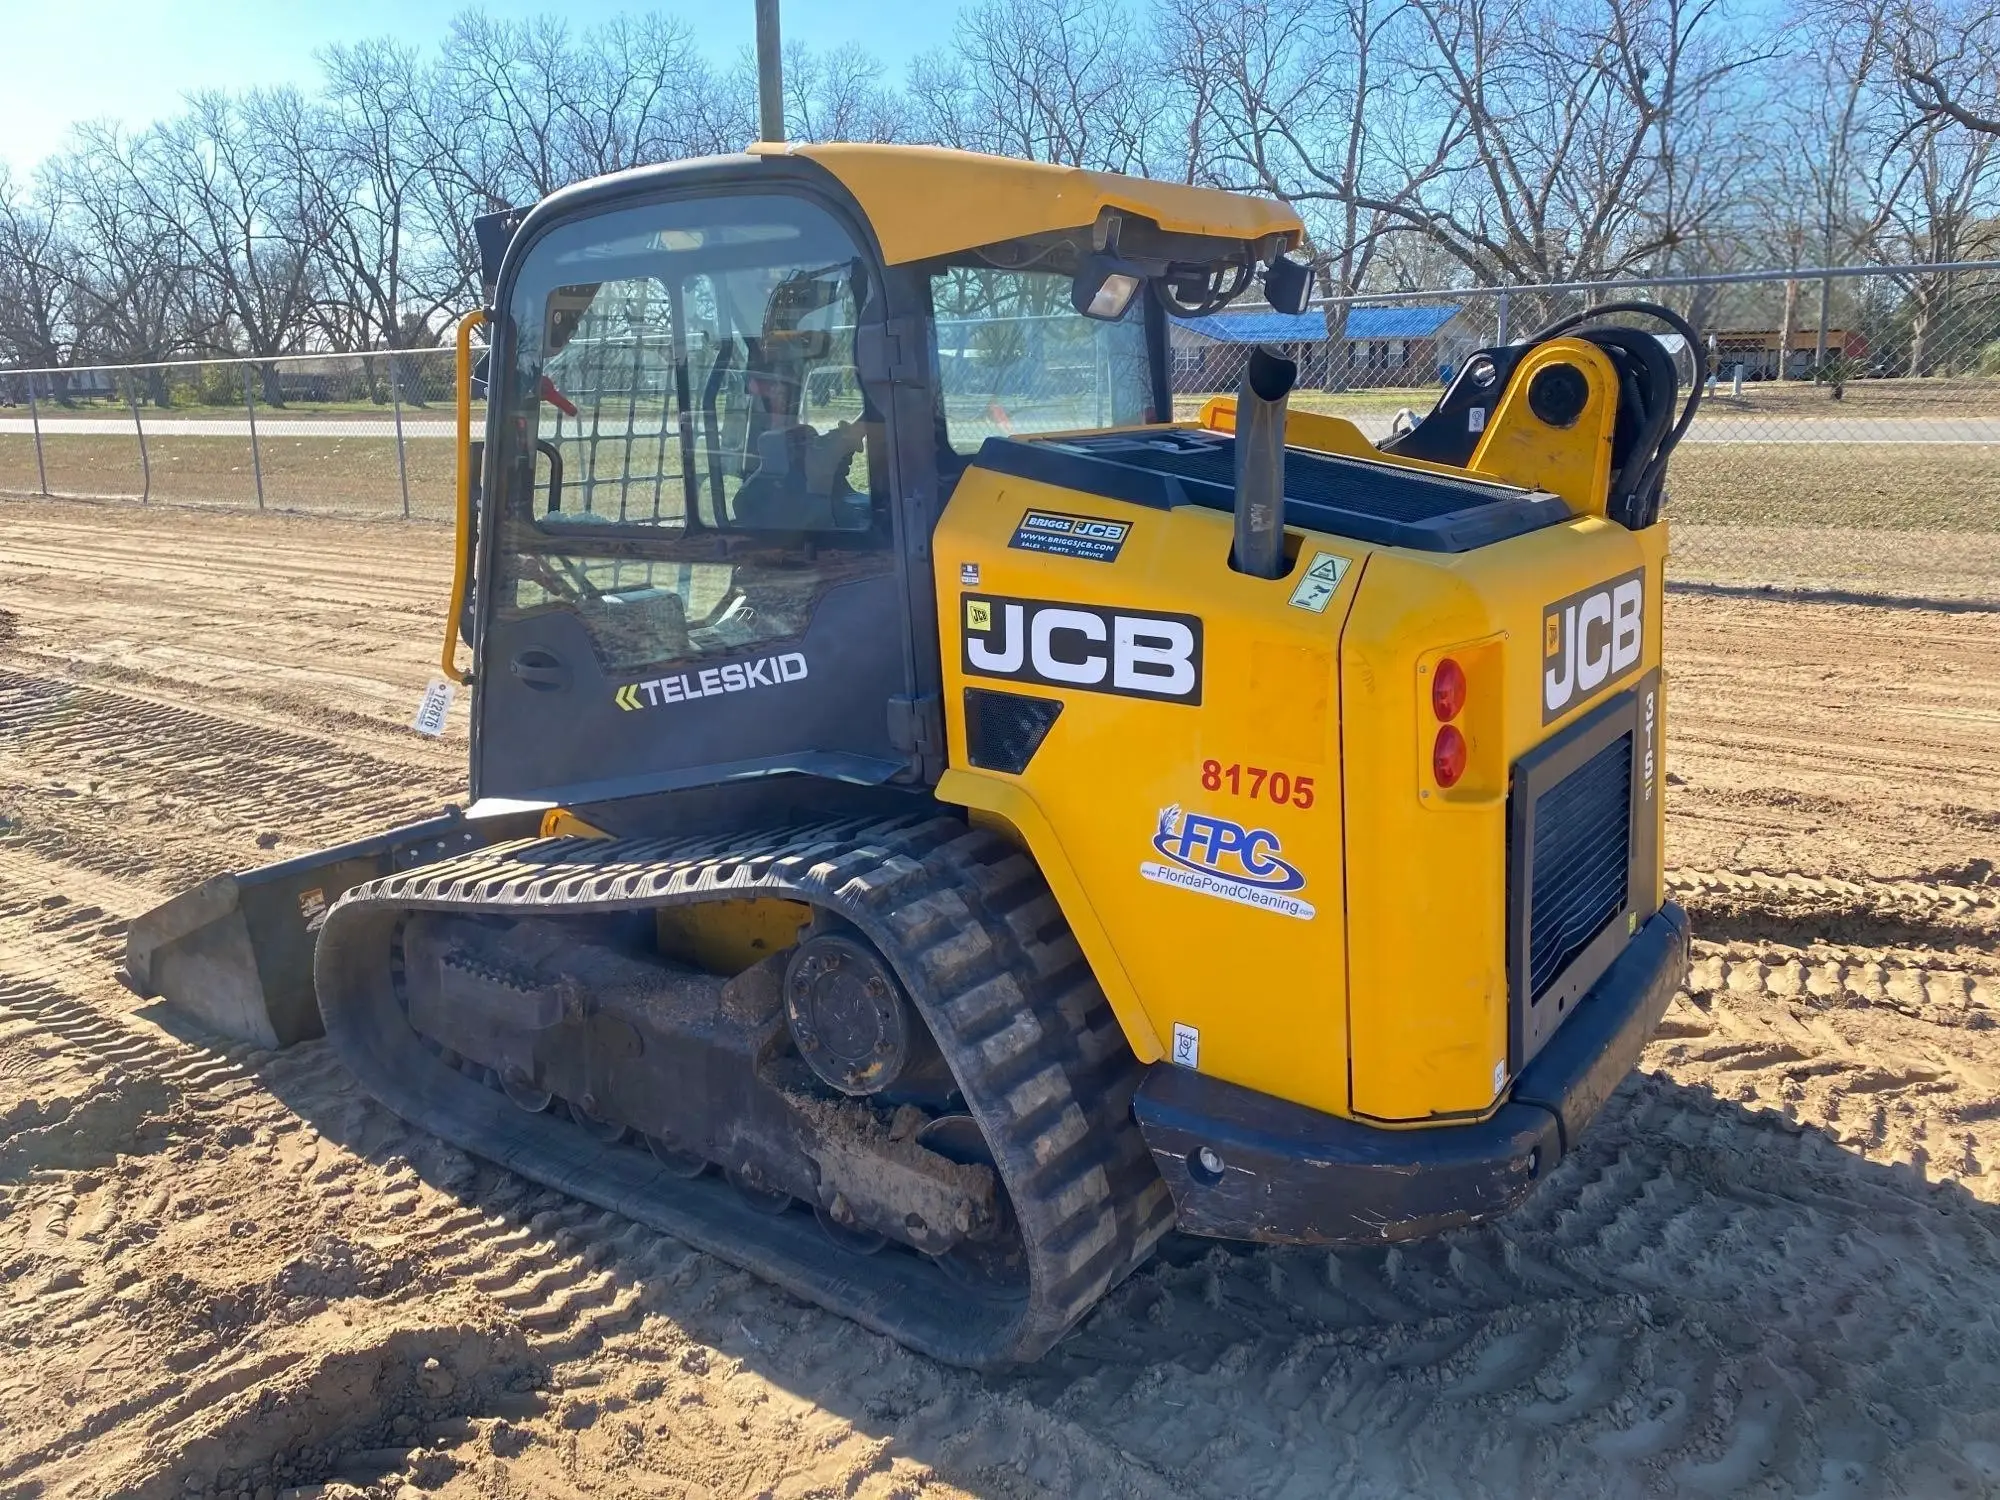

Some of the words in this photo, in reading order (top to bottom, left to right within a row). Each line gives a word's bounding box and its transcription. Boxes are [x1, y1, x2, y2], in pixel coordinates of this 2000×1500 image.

[1020, 532, 1114, 552] WWW.BRIGGSJCB.COM
[1028, 517, 1071, 531] BRIGGS
[1074, 522, 1123, 539] JCB
[1021, 541, 1040, 549] SALES
[1048, 546, 1069, 554] PARTS
[1078, 550, 1104, 559] SERVICE
[968, 603, 1196, 695] JCB
[1546, 579, 1642, 711] JCB
[639, 651, 808, 706] TELESKID
[424, 693, 447, 729] 122876
[1201, 759, 1314, 809] 81705
[1177, 813, 1281, 876] FPC
